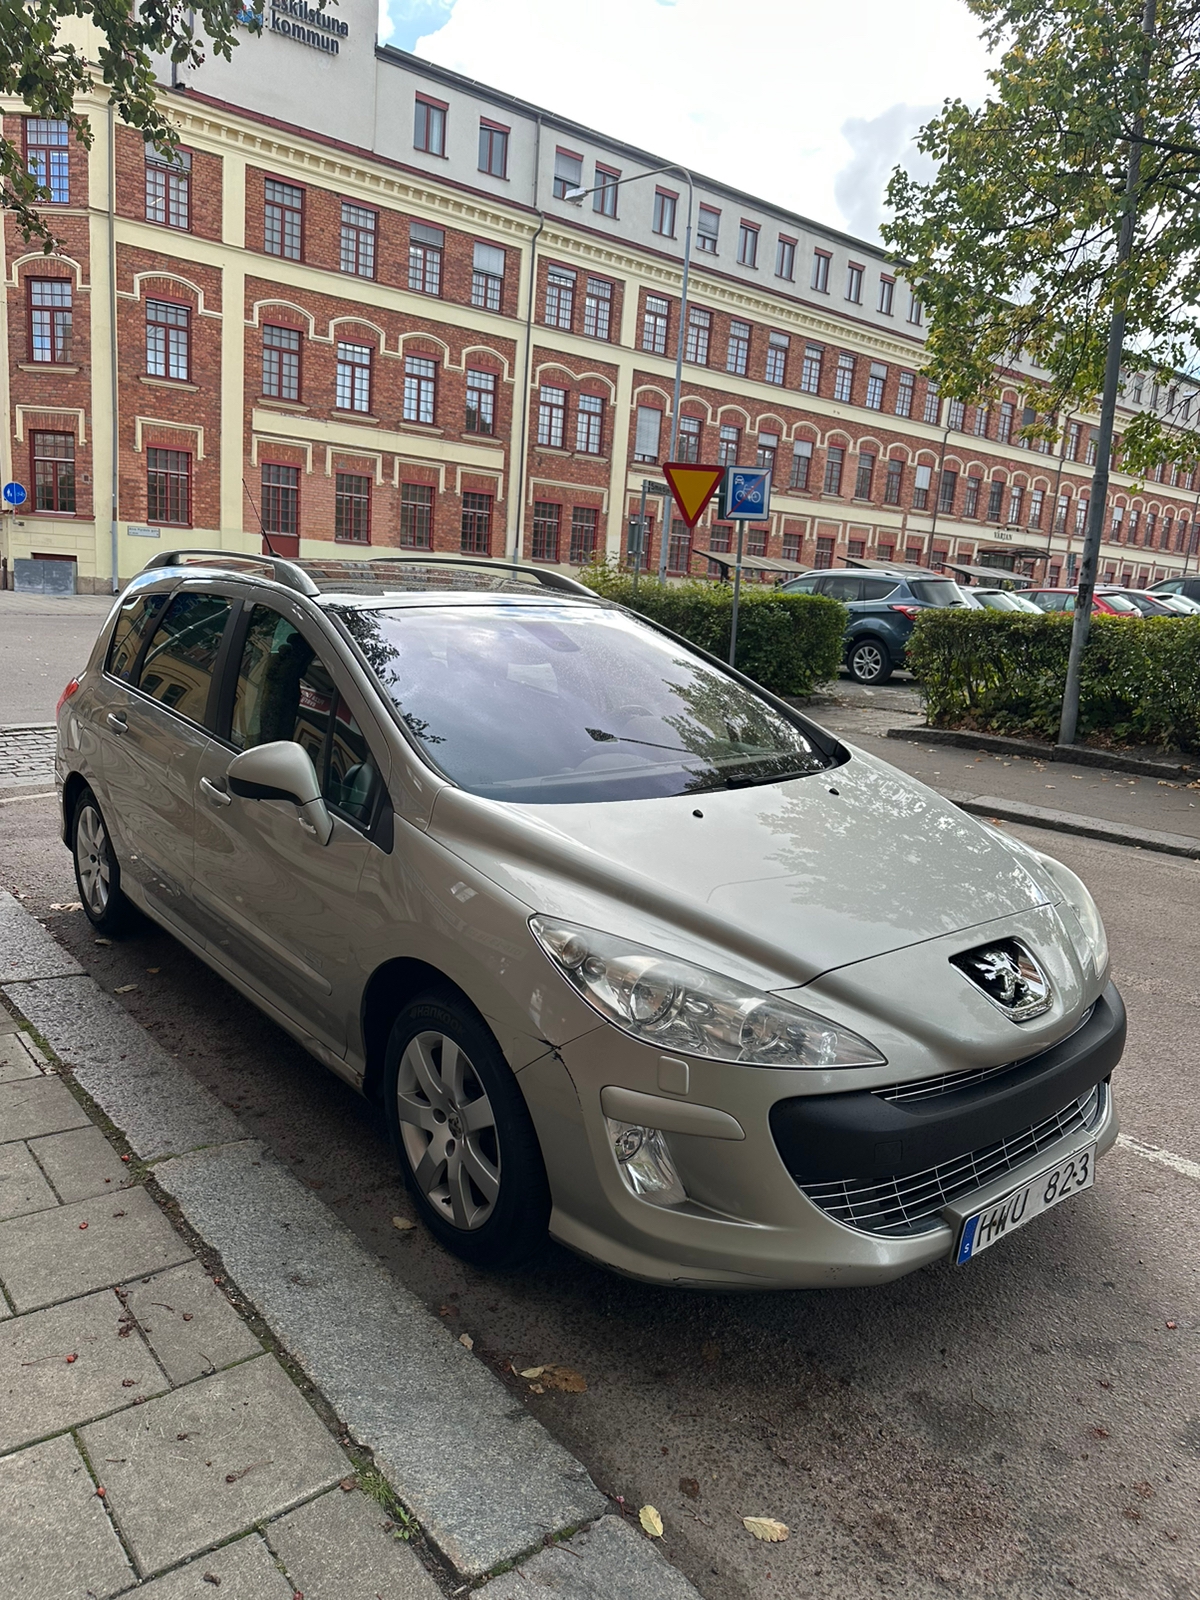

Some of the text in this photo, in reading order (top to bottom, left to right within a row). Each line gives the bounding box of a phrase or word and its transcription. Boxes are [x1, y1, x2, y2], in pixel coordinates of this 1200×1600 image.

[271, 10, 340, 54] kommun
[963, 1152, 1090, 1254] S HWU 823
